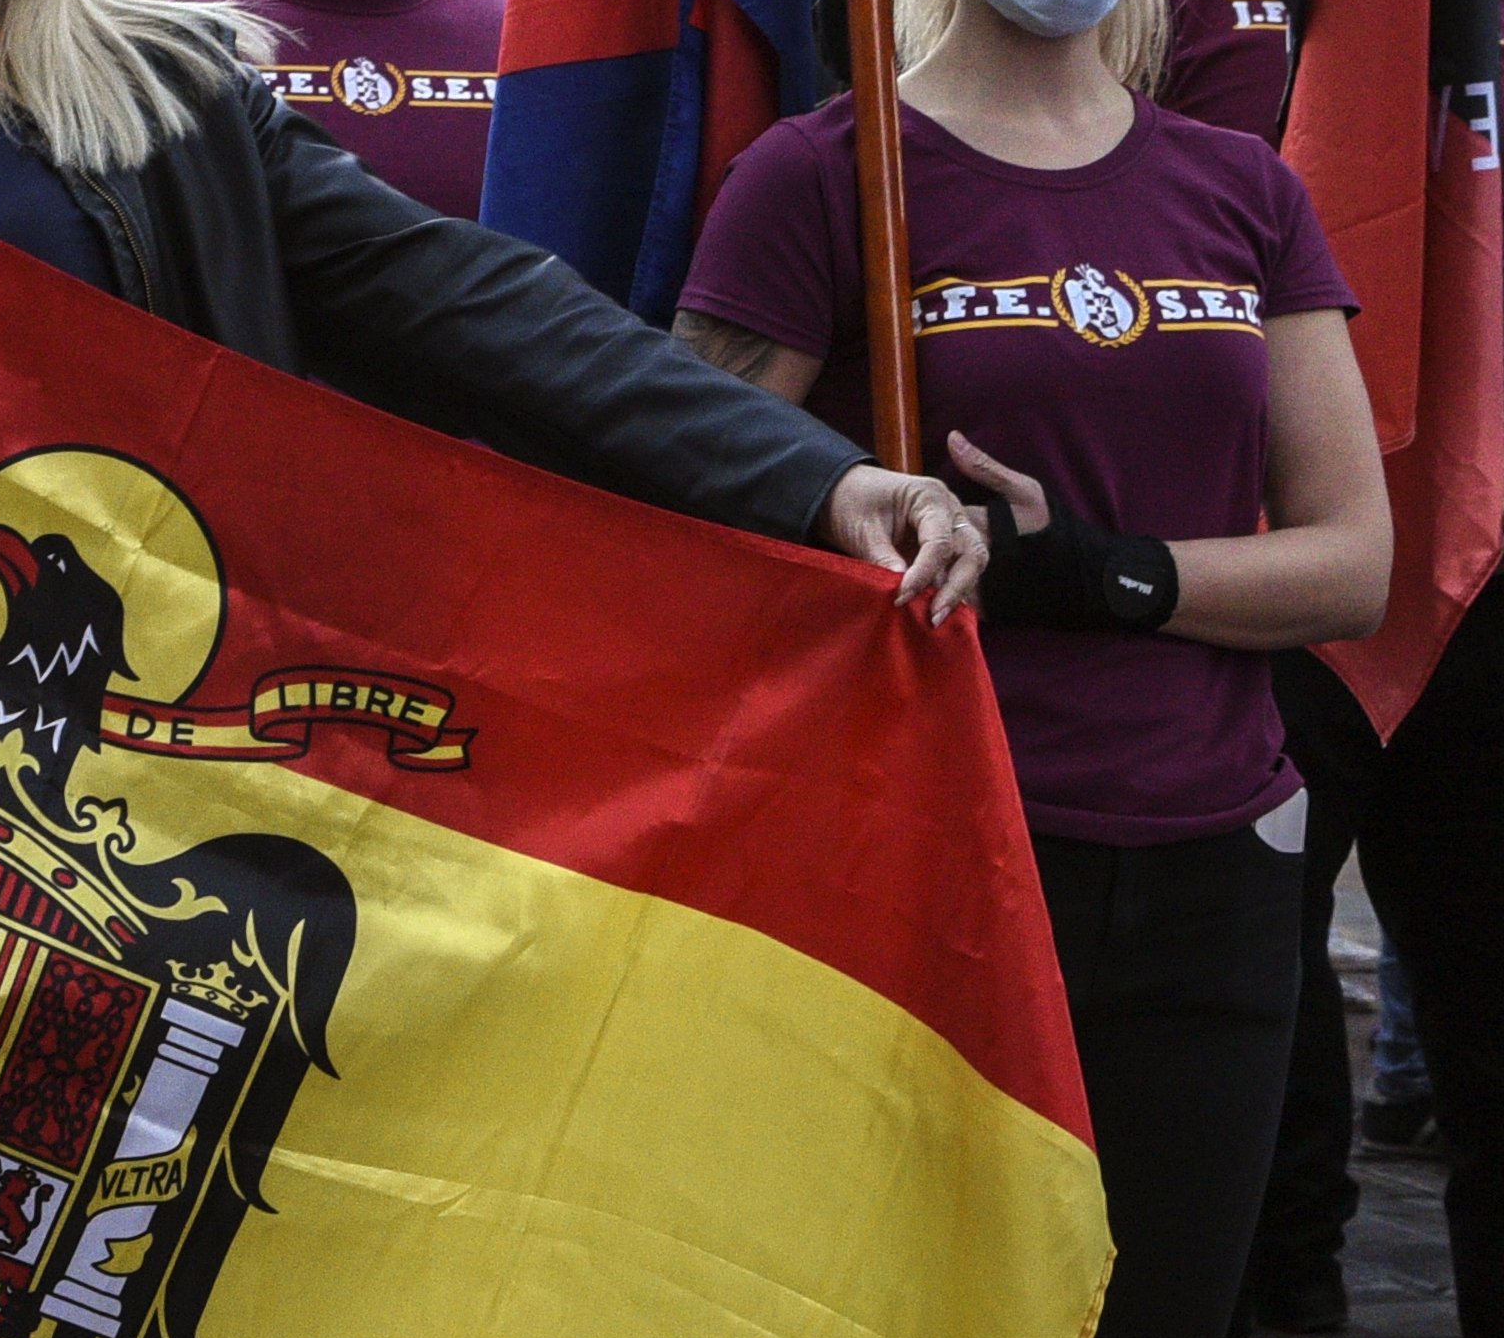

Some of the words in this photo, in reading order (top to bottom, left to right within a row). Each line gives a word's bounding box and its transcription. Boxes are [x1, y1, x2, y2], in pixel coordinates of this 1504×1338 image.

[911, 285, 1052, 335] .F.E.
[125, 707, 196, 747] DE
[276, 679, 431, 728] LIBRE
[100, 1157, 183, 1201] VLTRA
